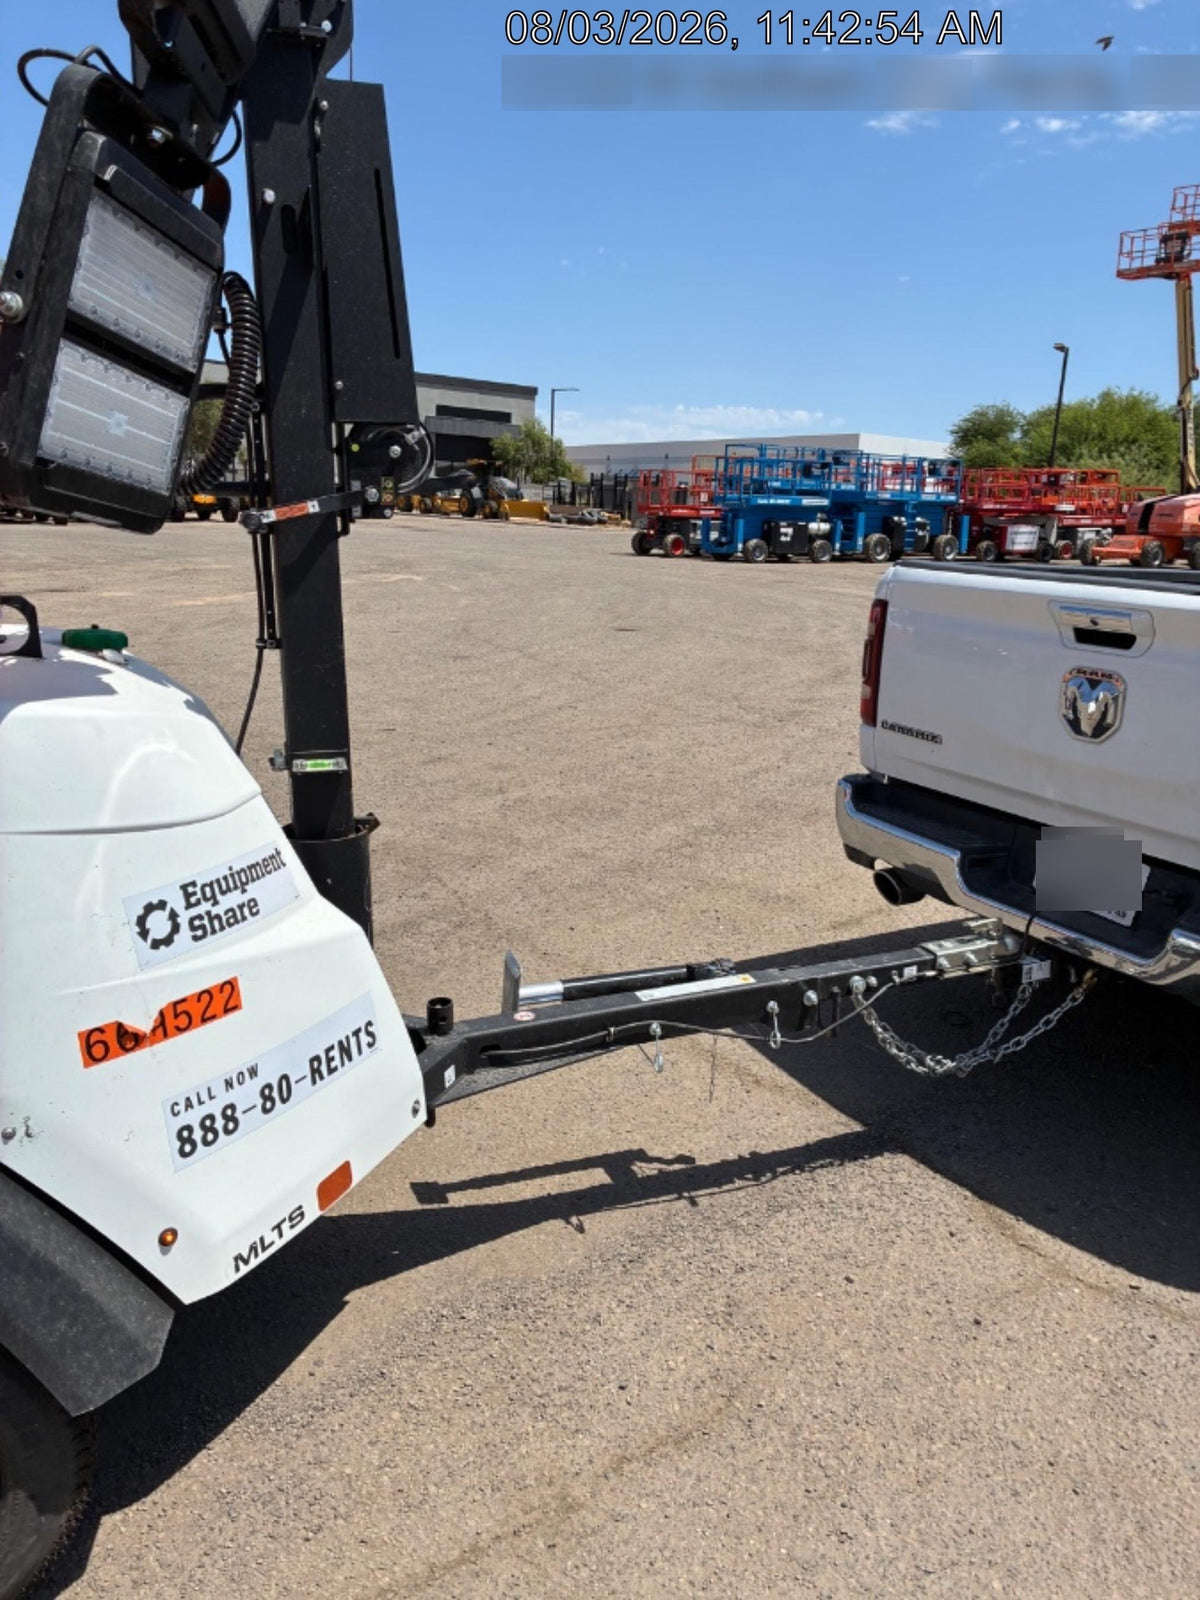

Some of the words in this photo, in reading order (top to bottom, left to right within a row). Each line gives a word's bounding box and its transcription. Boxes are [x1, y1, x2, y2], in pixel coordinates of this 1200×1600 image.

[179, 847, 287, 911] Equipment
[187, 897, 261, 943] Share
[170, 1086, 217, 1118] CALL
[224, 1063, 260, 1093] NOW
[176, 1019, 378, 1159] 888-80-RENTS
[232, 1204, 306, 1274] MLTS
